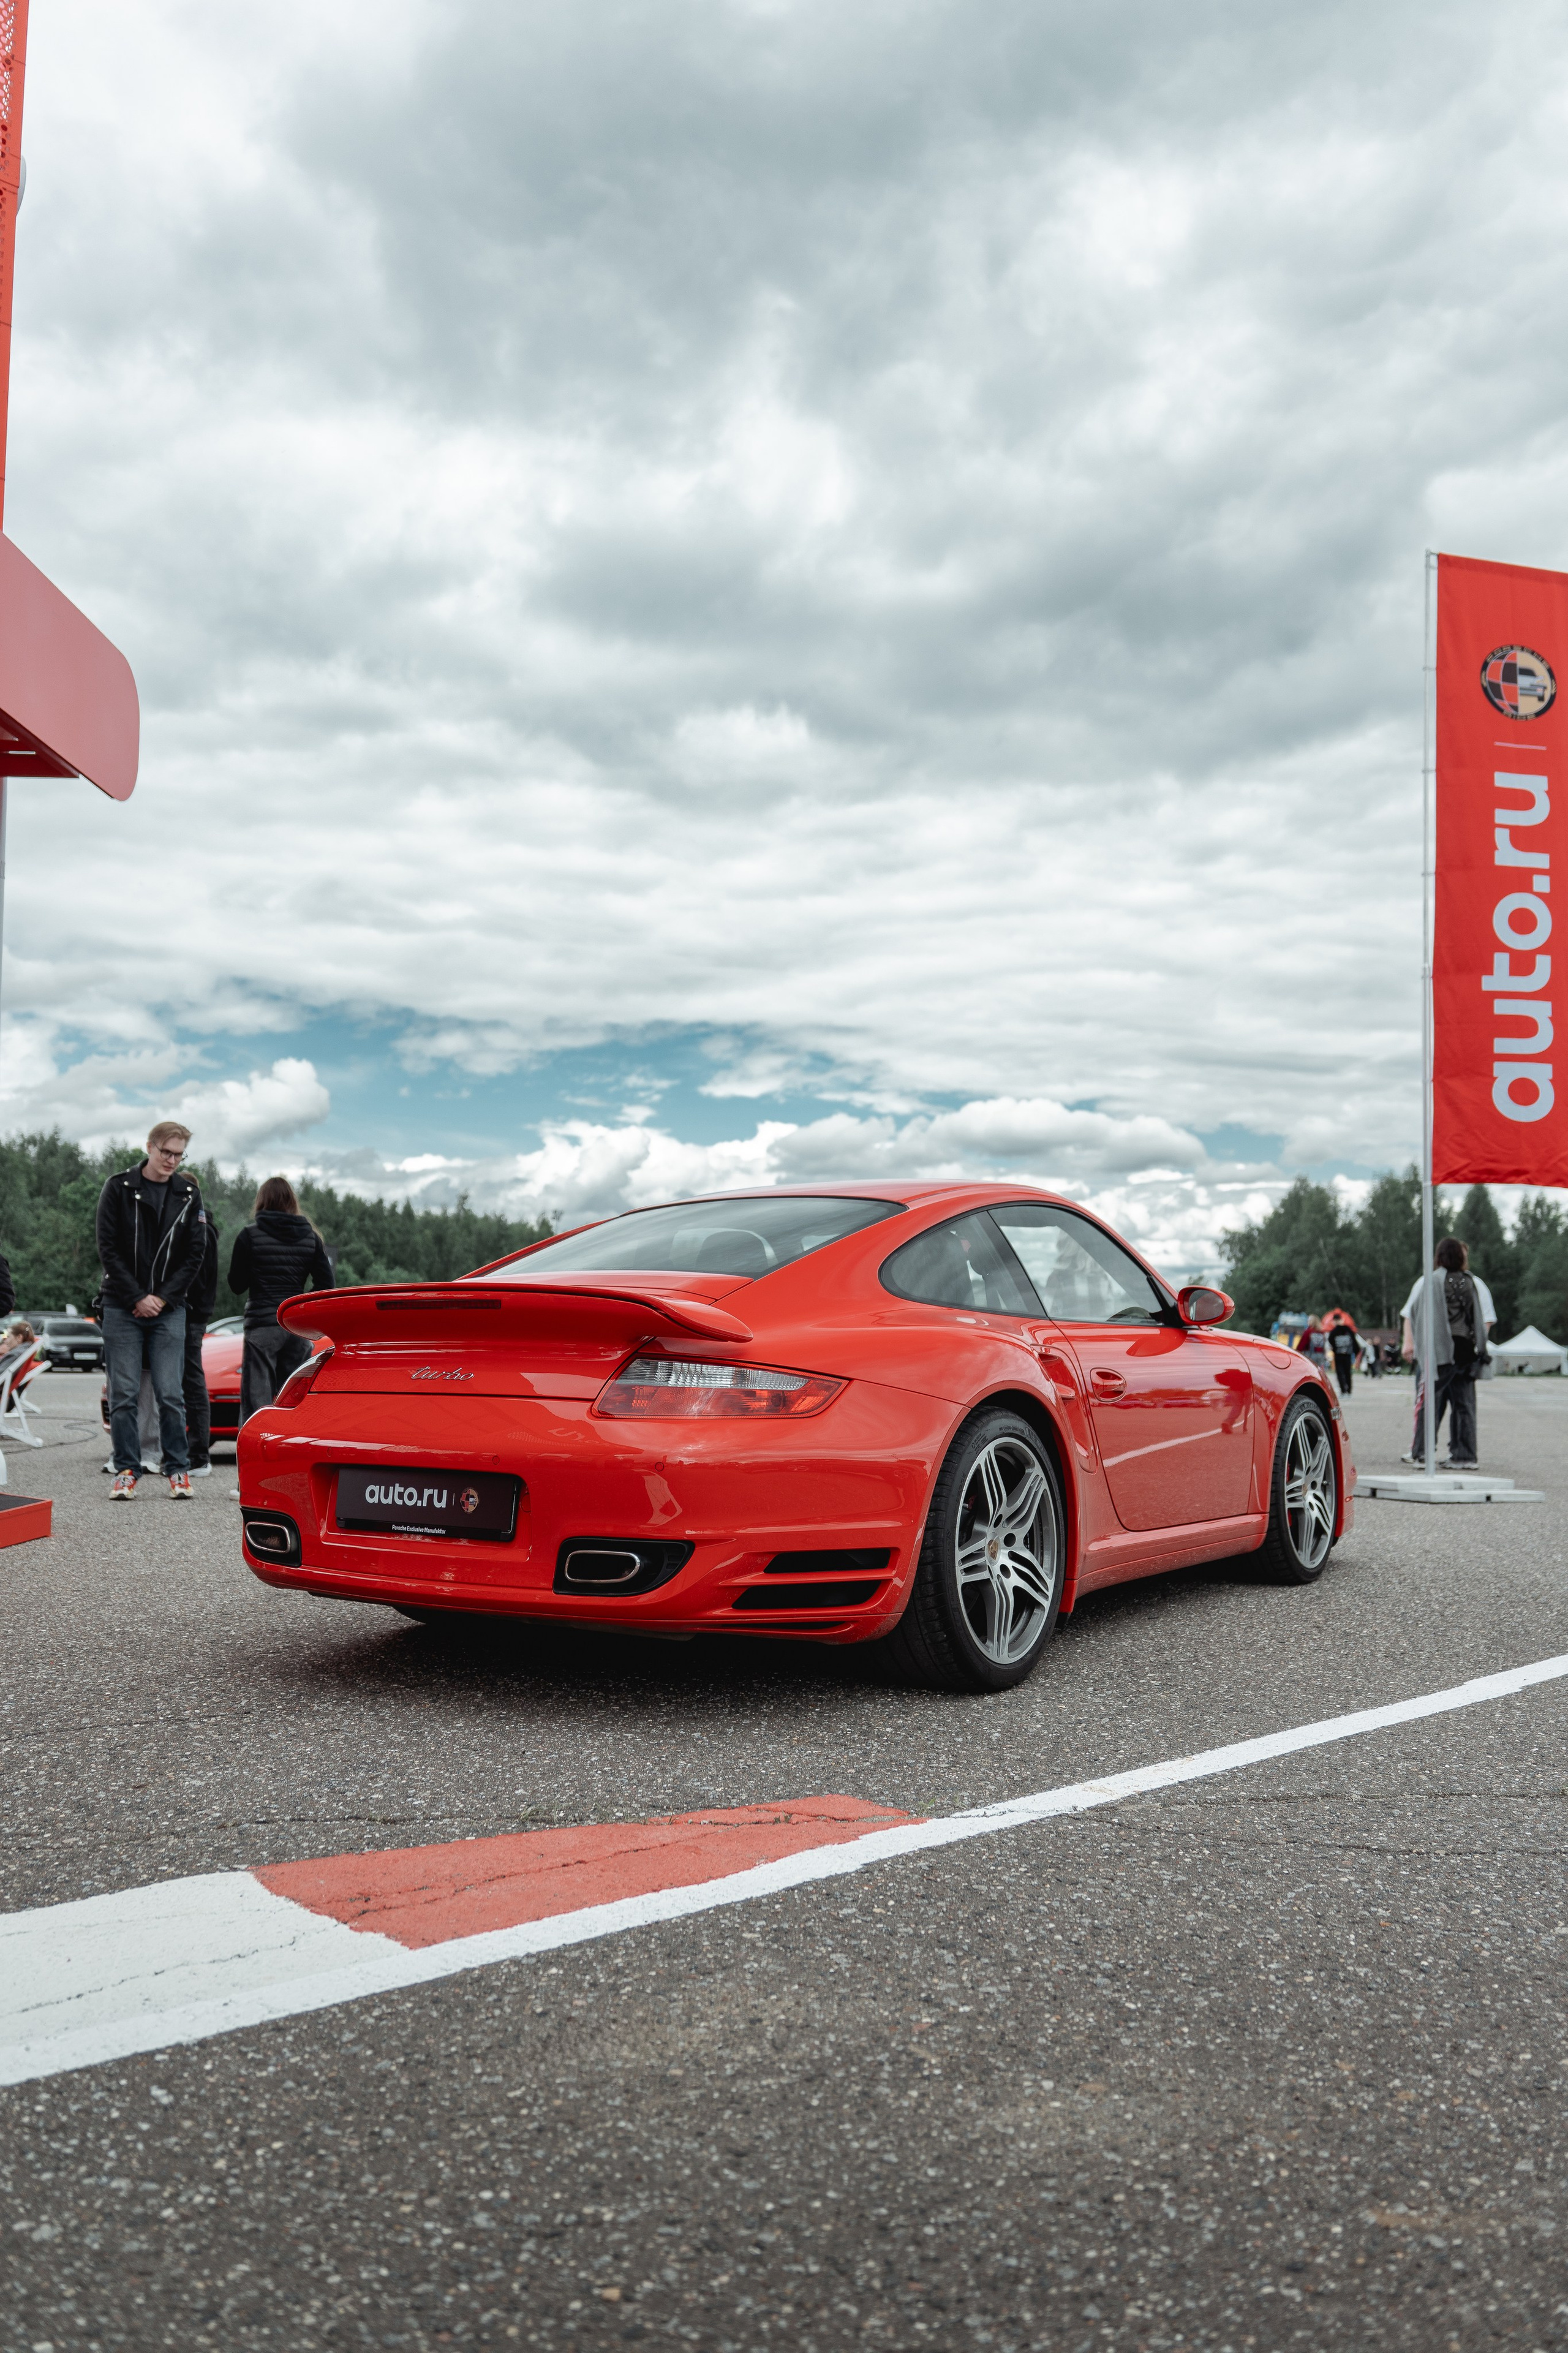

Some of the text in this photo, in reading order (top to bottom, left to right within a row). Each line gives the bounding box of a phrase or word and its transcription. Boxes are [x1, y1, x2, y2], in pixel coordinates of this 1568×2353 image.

[1482, 771, 1555, 1123] auto.ru
[410, 1366, 474, 1381] turbo
[365, 1483, 447, 1508] auto.ru
